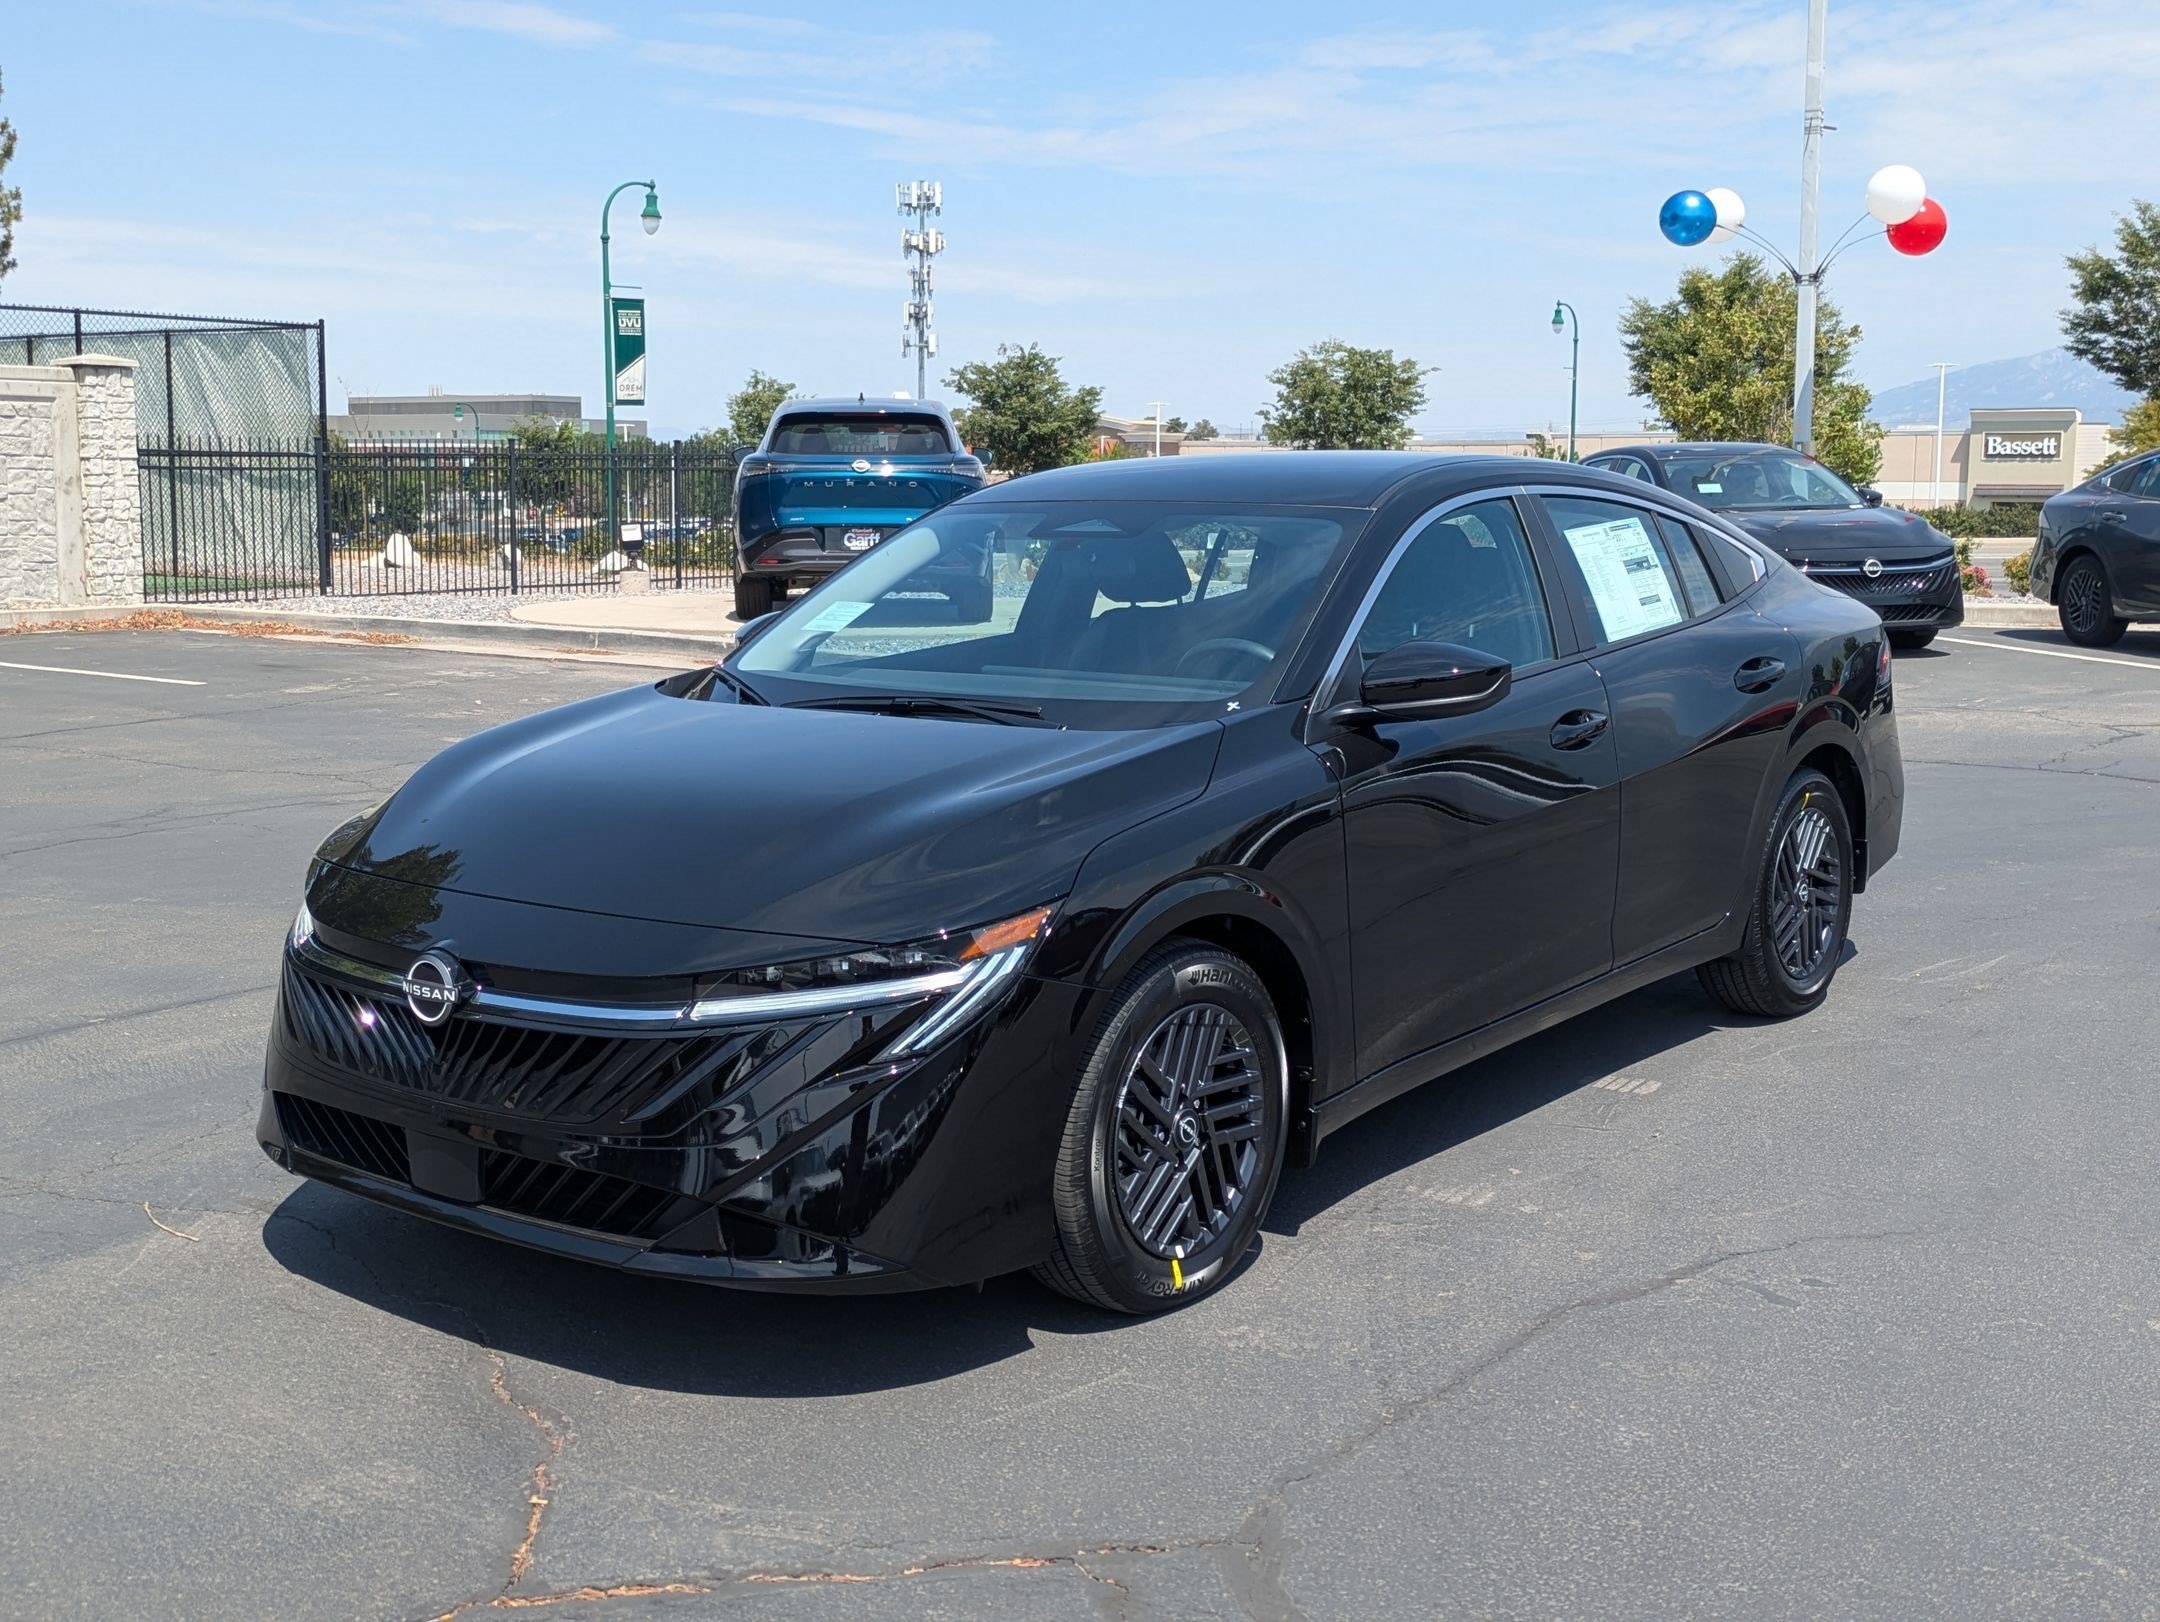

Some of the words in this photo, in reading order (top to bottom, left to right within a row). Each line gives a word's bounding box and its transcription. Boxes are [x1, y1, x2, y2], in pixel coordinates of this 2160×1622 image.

[618, 318, 641, 327] UVU
[619, 384, 642, 392] OREM
[1987, 436, 2057, 455] Bassett
[402, 980, 455, 1001] NISSAN
